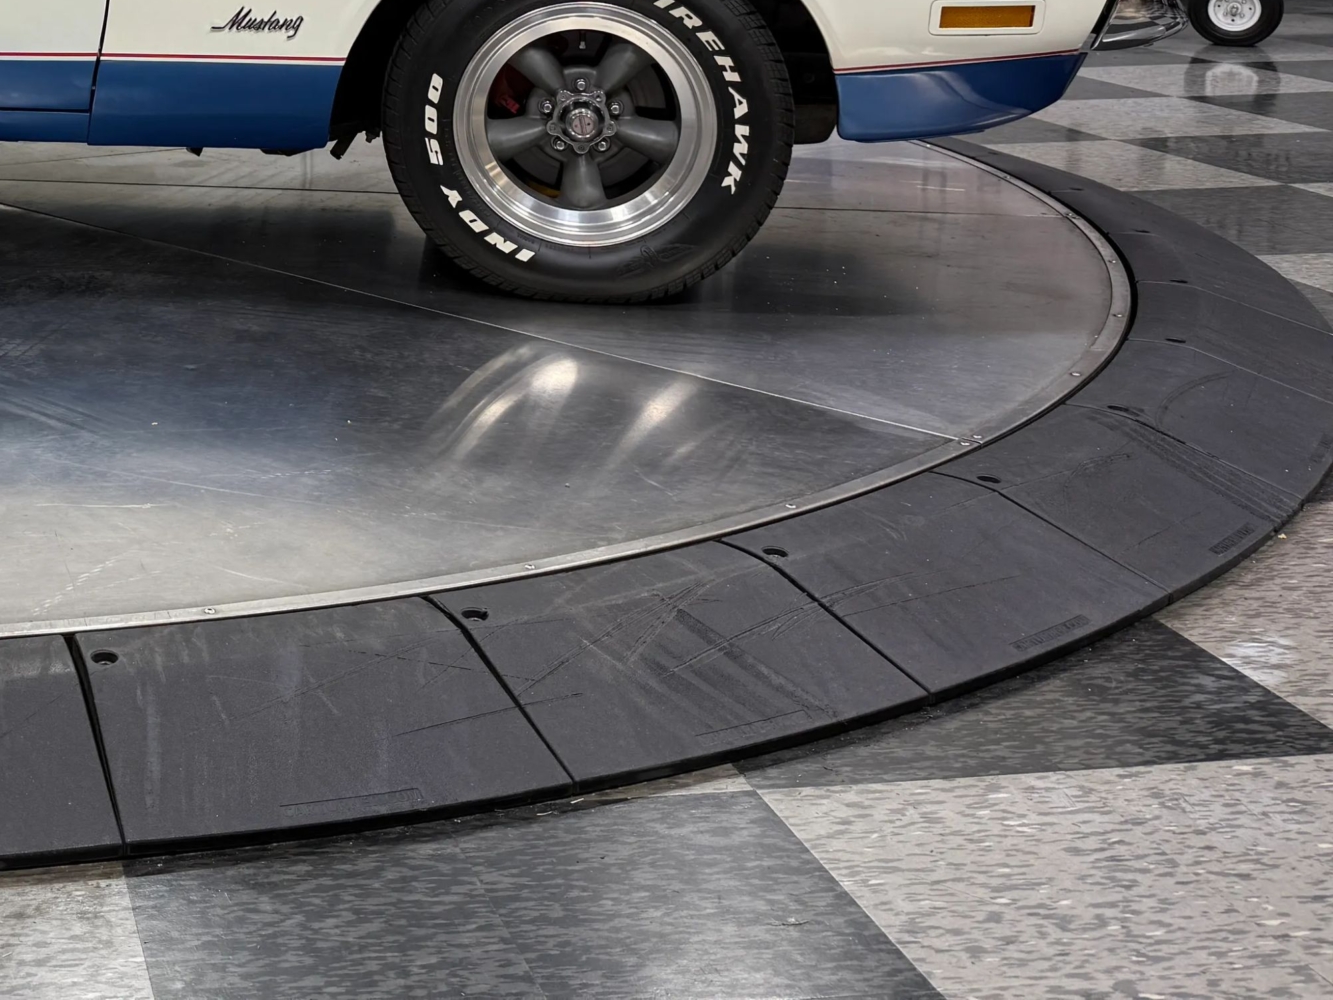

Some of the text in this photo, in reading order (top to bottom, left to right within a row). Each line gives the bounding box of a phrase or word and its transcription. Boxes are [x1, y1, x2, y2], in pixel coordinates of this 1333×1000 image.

[210, 5, 304, 39] Mustang
[424, 73, 536, 263] INDY 500
